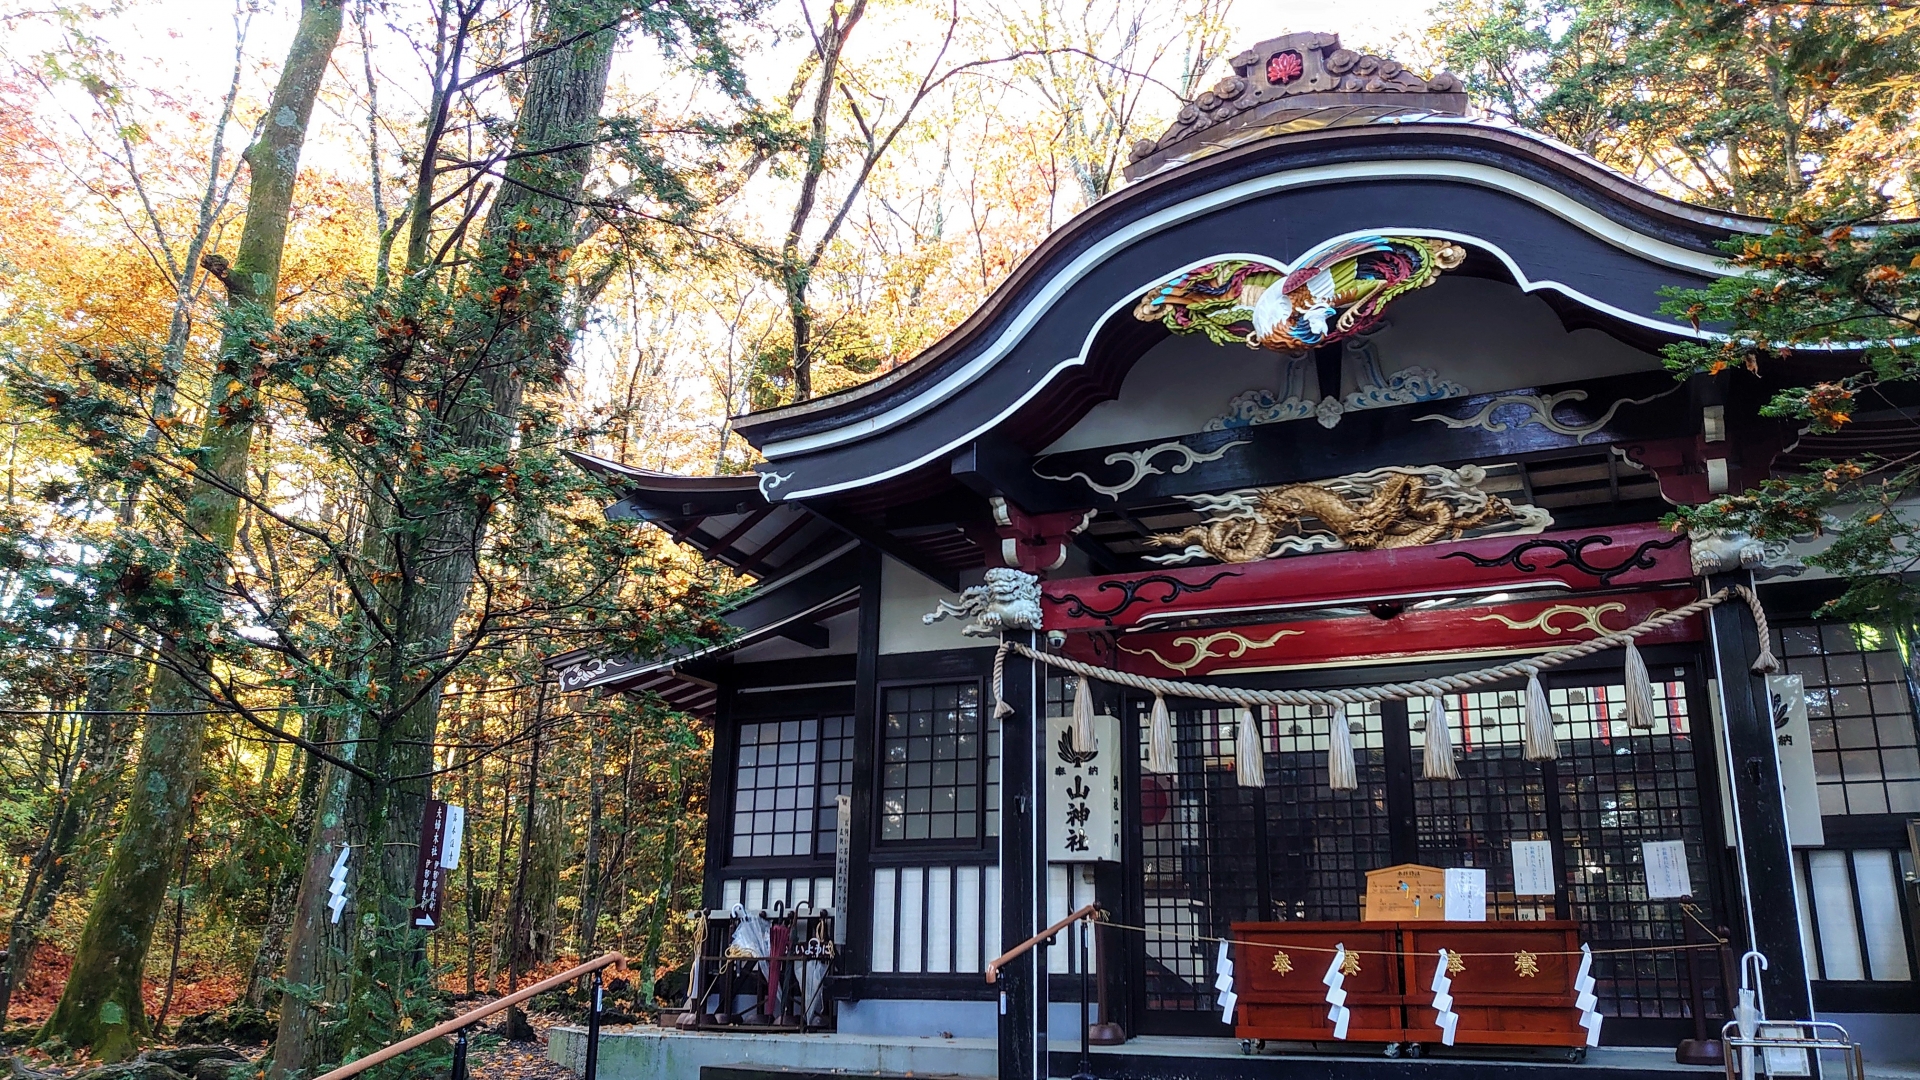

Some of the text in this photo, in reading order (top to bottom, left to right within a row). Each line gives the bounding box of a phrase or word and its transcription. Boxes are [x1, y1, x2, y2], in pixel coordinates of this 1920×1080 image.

[1778, 734, 1793, 746] 納
[1054, 765, 1099, 777] 奉 納
[1064, 774, 1091, 853] 山神社
[431, 806, 443, 857] 夫婦木社
[1271, 950, 1294, 977] 奉
